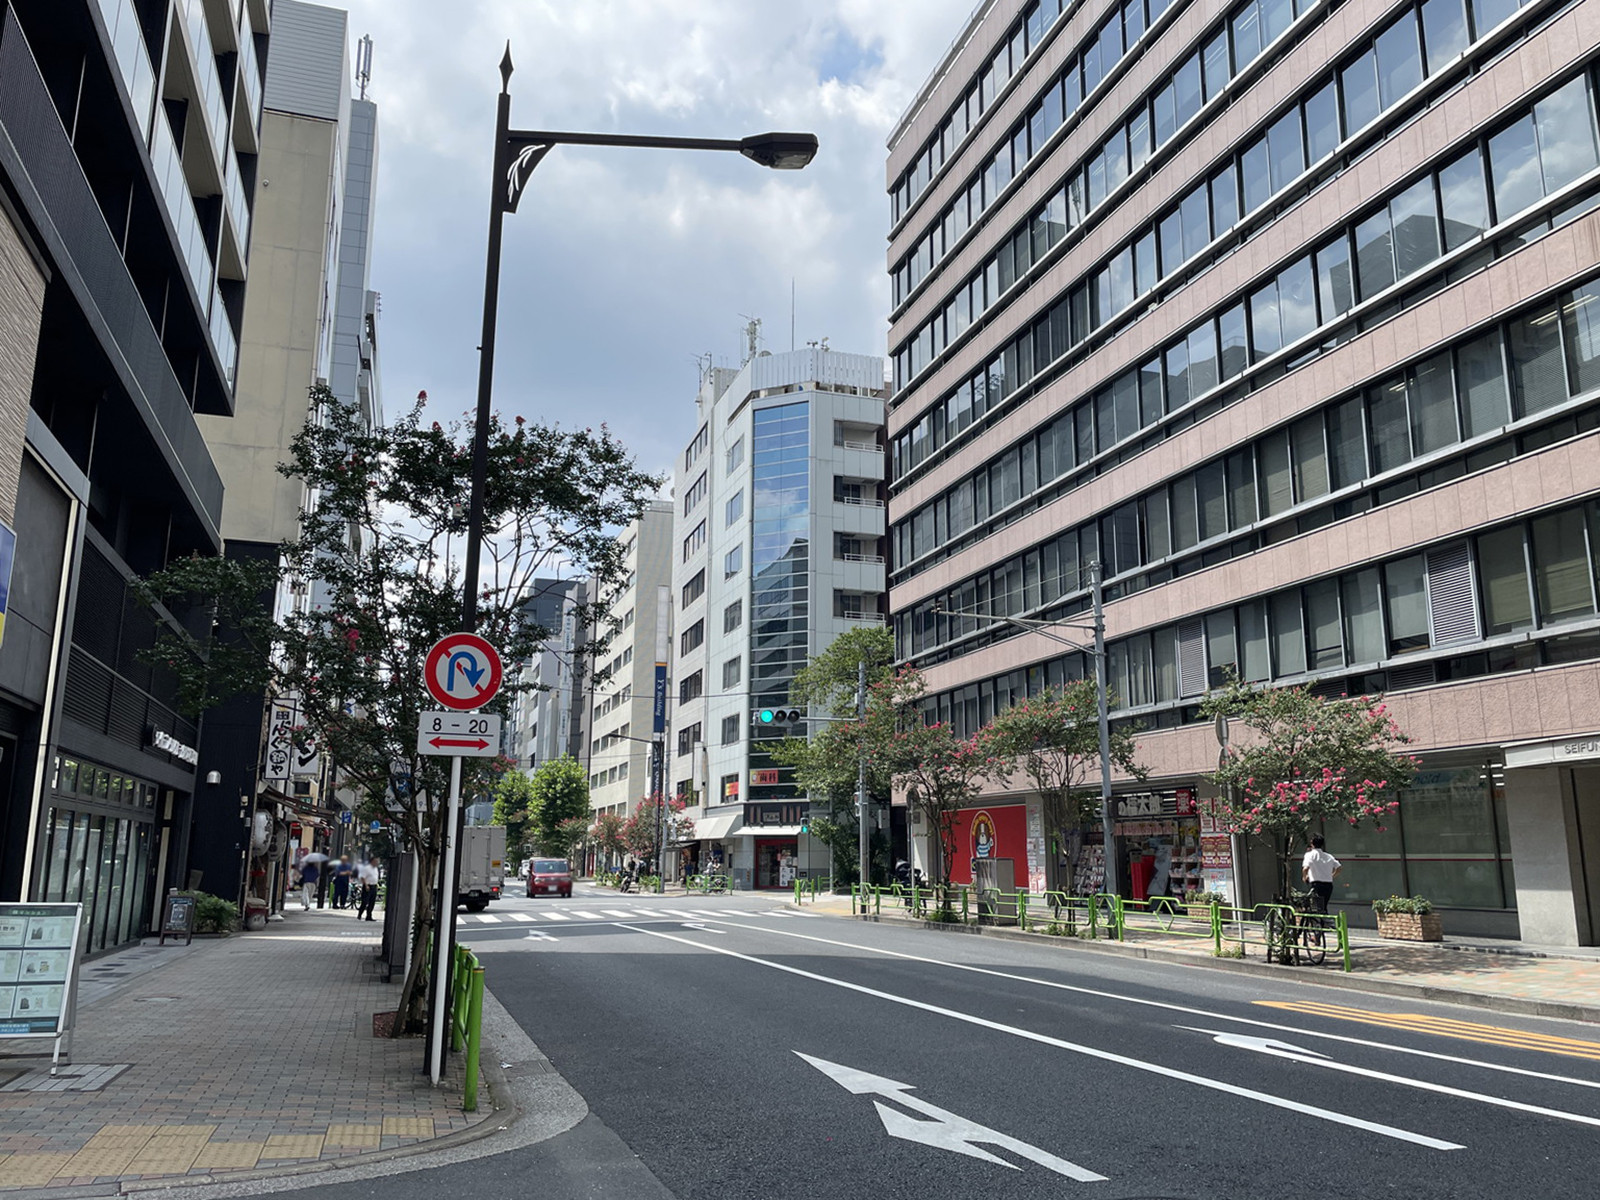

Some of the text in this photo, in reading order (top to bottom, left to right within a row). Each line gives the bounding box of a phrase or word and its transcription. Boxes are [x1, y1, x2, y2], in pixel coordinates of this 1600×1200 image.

[432, 717, 442, 732] 8
[468, 719, 488, 734] 20
[1176, 792, 1190, 814] 薬
